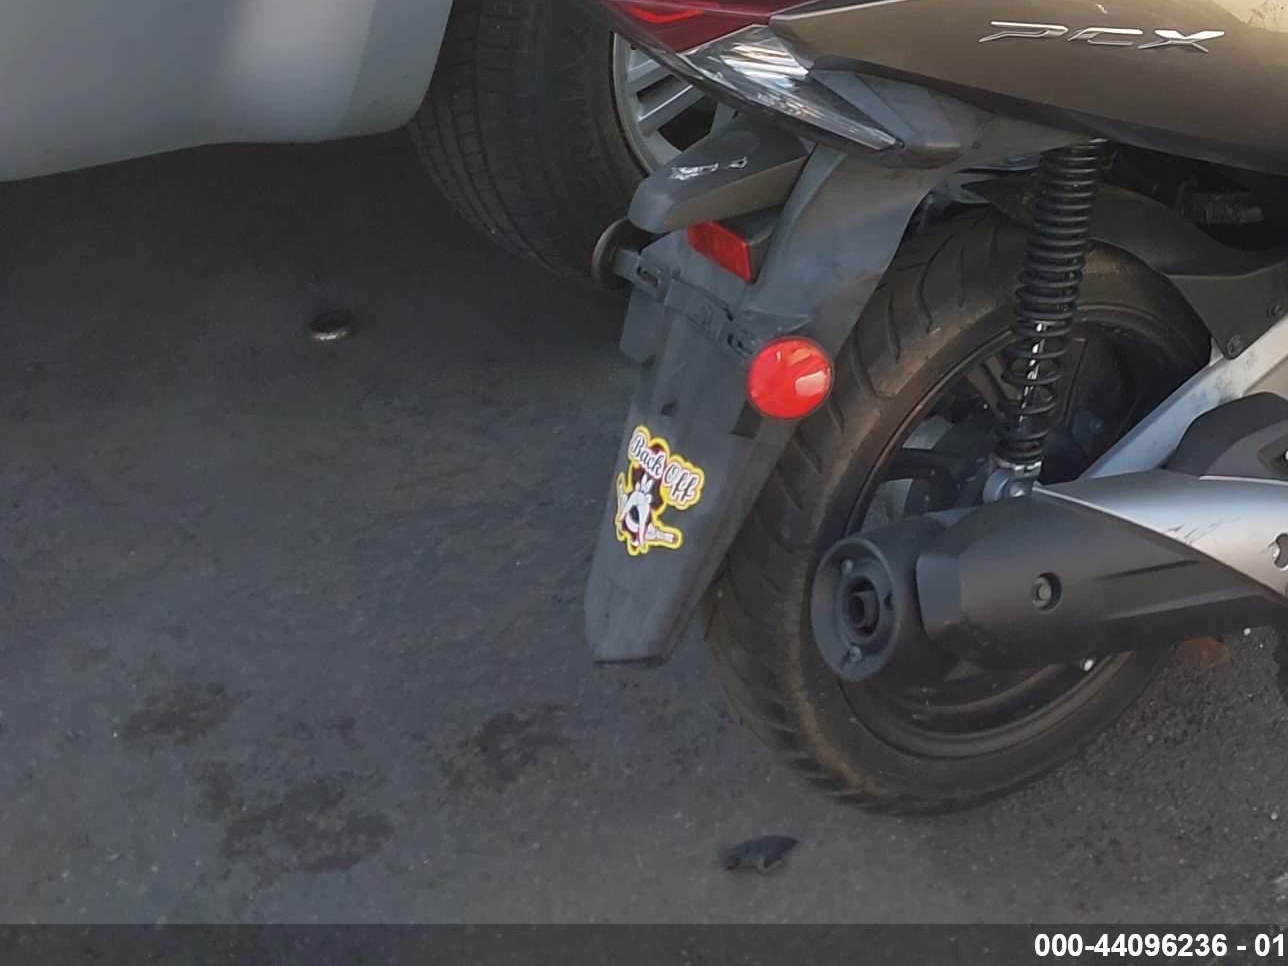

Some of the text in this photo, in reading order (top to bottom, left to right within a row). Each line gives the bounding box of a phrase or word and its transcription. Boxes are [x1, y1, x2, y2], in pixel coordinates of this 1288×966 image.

[978, 20, 1226, 53] PCX
[631, 433, 699, 503] Back Off
